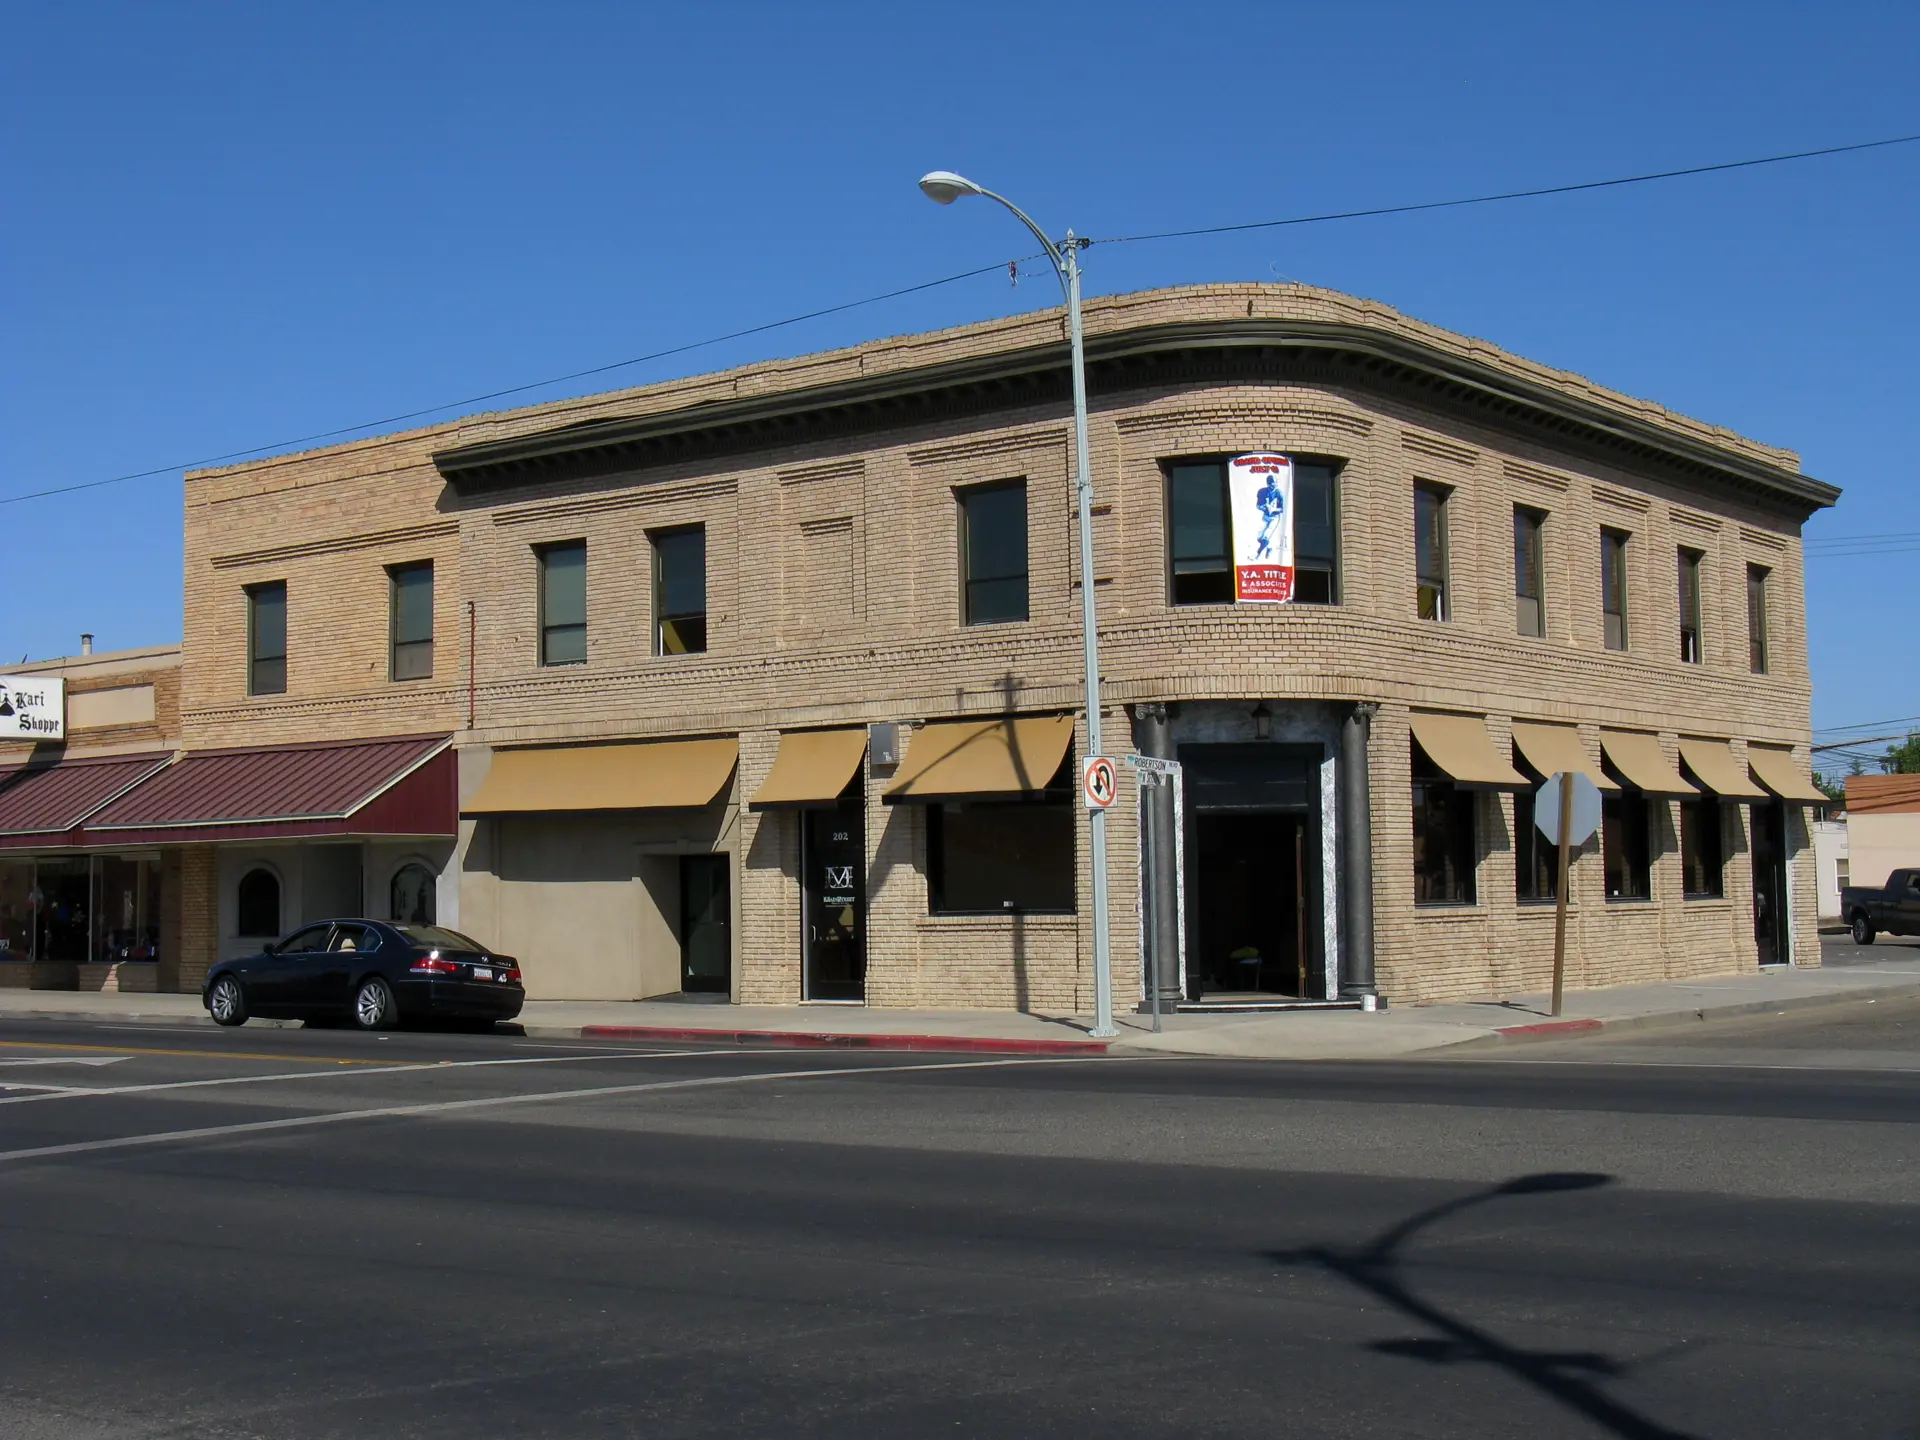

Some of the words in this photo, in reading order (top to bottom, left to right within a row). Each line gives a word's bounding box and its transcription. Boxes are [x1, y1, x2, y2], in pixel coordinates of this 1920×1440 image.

[1241, 570, 1261, 579] Y.A.
[15, 691, 45, 709] Kari
[19, 713, 60, 733] Shoppe
[1134, 757, 1167, 771] ROBERTSON
[832, 832, 849, 841] 202
